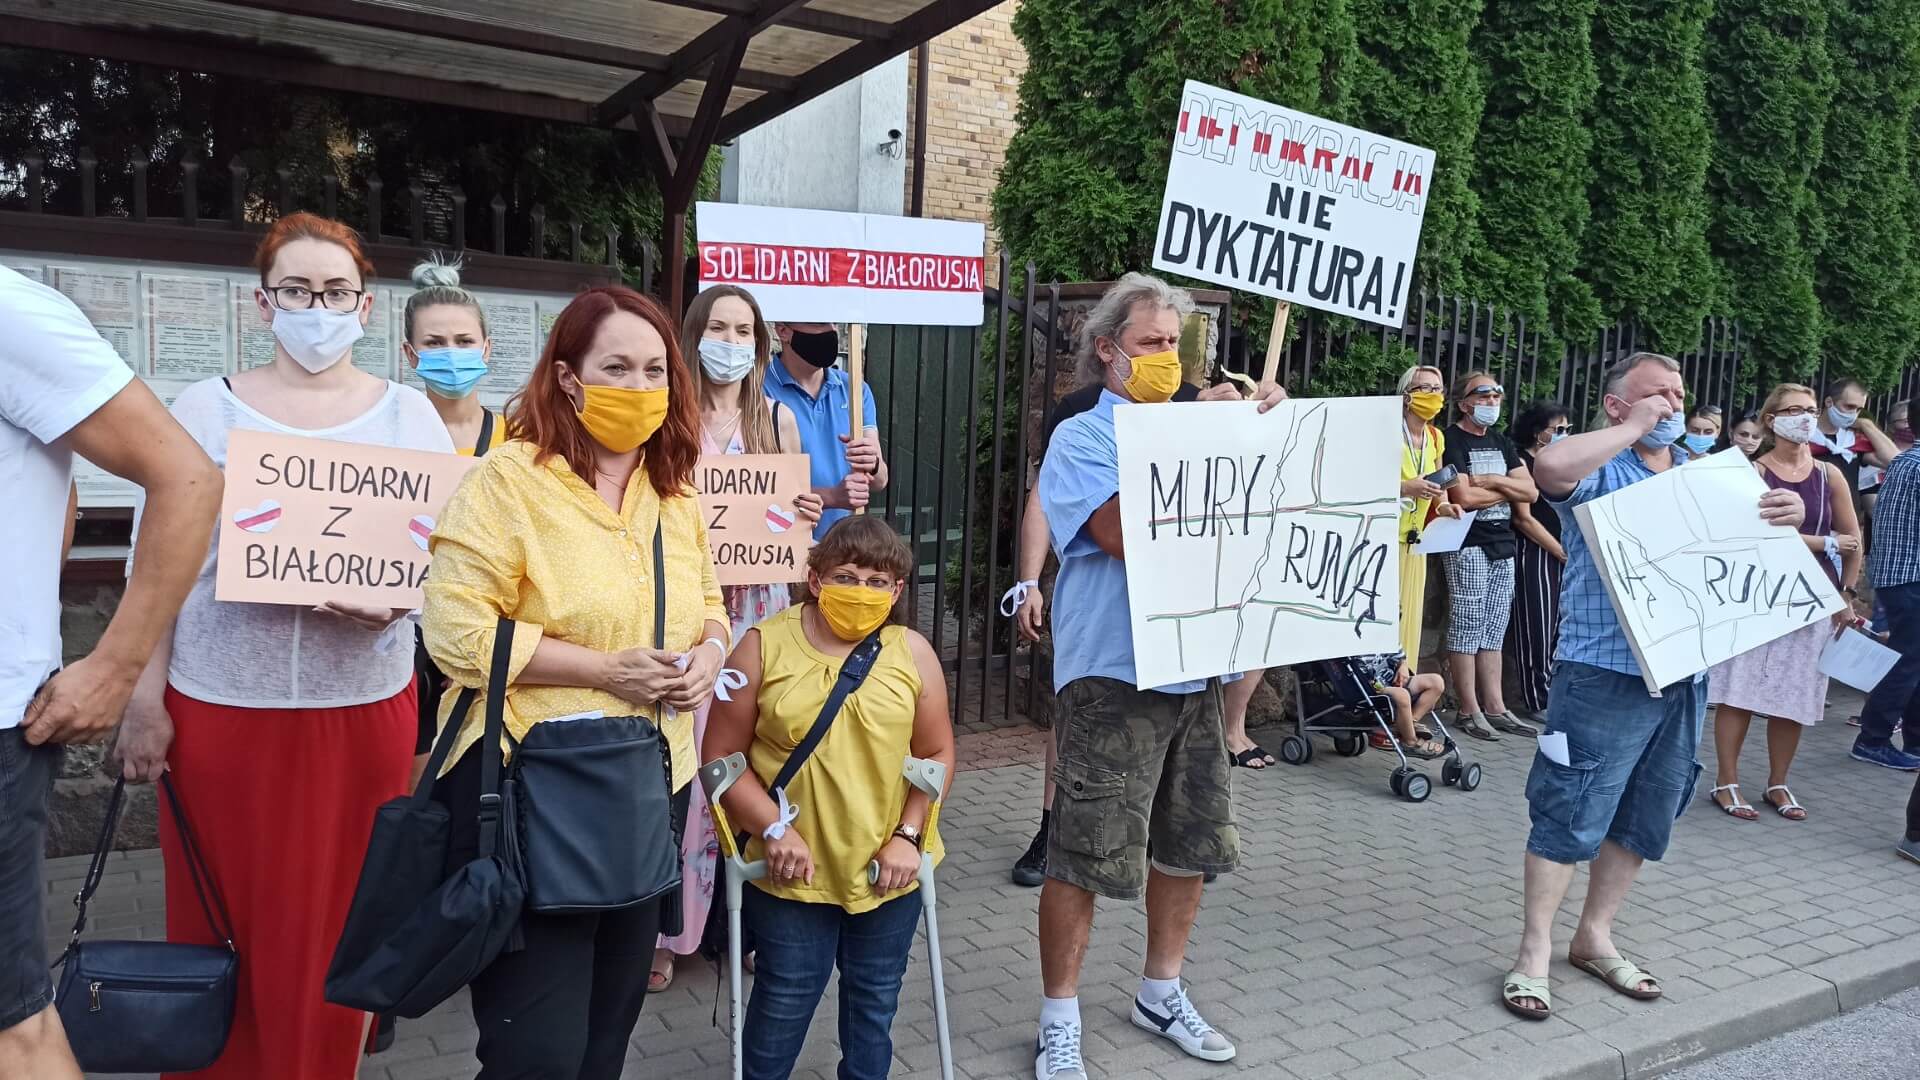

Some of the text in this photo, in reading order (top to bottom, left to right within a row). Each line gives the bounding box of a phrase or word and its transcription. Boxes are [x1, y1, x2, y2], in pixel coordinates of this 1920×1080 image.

[1175, 91, 1423, 215] DEMOKRACJA
[1266, 183, 1336, 231] NIE
[703, 246, 983, 292] SOLIDARNI Z BIAŁORUSIĄ
[1161, 201, 1405, 318] DYKTATURA!
[255, 453, 431, 503] SOLIDARNI
[692, 467, 777, 495] LIDARNI
[1150, 455, 1266, 541] MURY
[321, 506, 353, 538] Z
[708, 505, 729, 530] Z
[712, 542, 795, 571] ORUSIĄ
[1281, 521, 1389, 640] RUNĄ
[1703, 555, 1826, 623] RUNĄ
